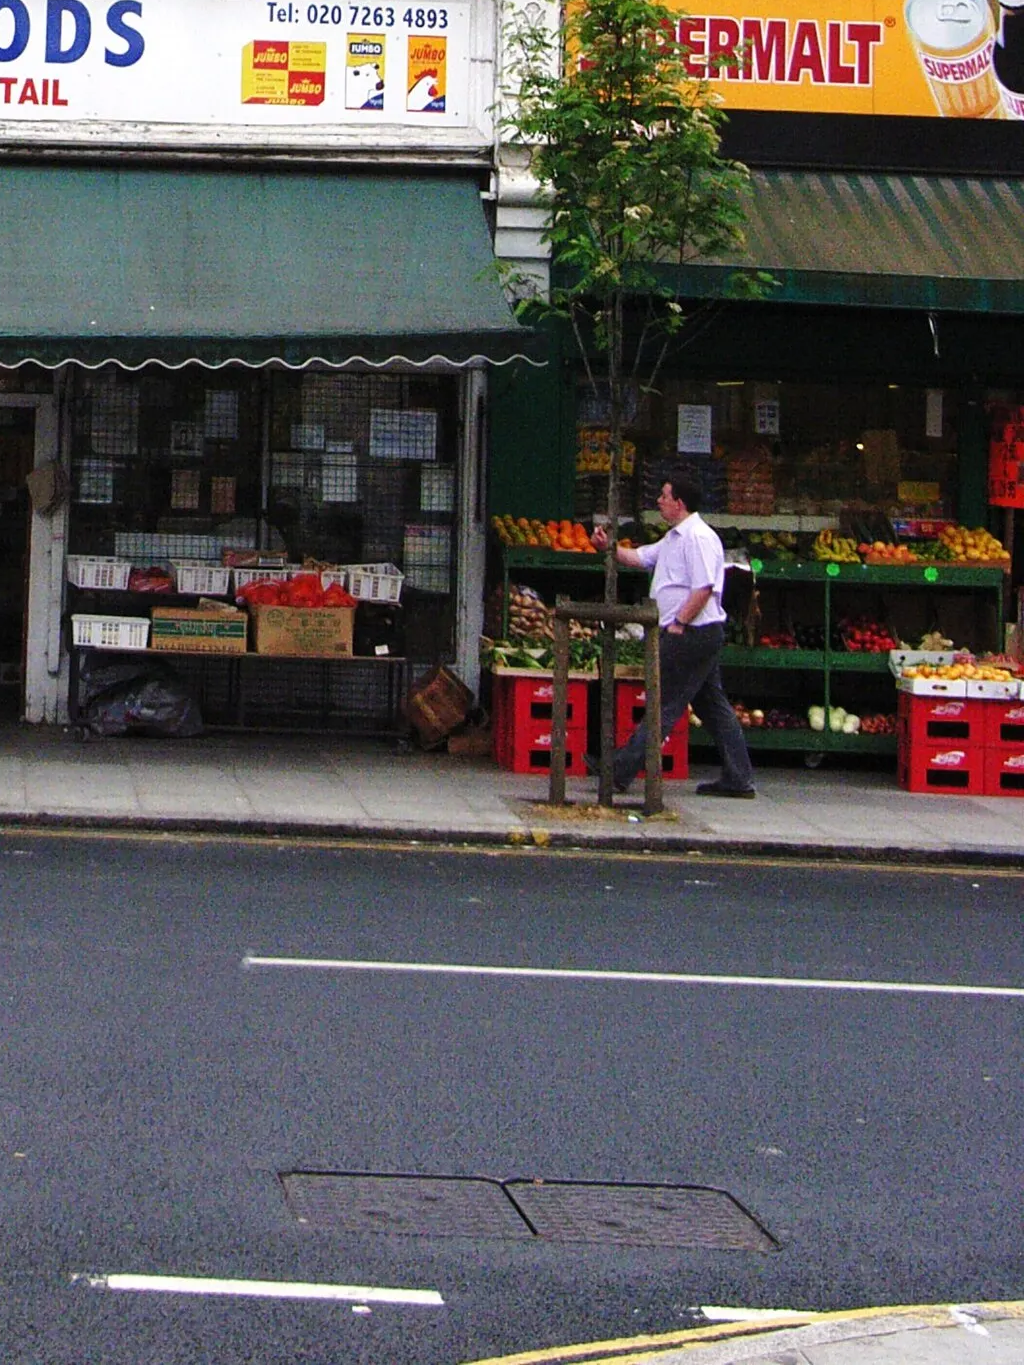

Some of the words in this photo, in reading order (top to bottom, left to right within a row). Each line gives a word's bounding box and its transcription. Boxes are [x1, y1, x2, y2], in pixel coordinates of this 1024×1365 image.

[266, 1, 300, 23] Tel:
[307, 4, 343, 25] 020
[349, 5, 395, 27] 7263
[403, 8, 449, 29] 4893
[350, 43, 383, 55] JUMBO
[410, 47, 446, 62] JUMBO
[253, 50, 288, 64] JUMBO
[289, 80, 323, 95] JUMBO
